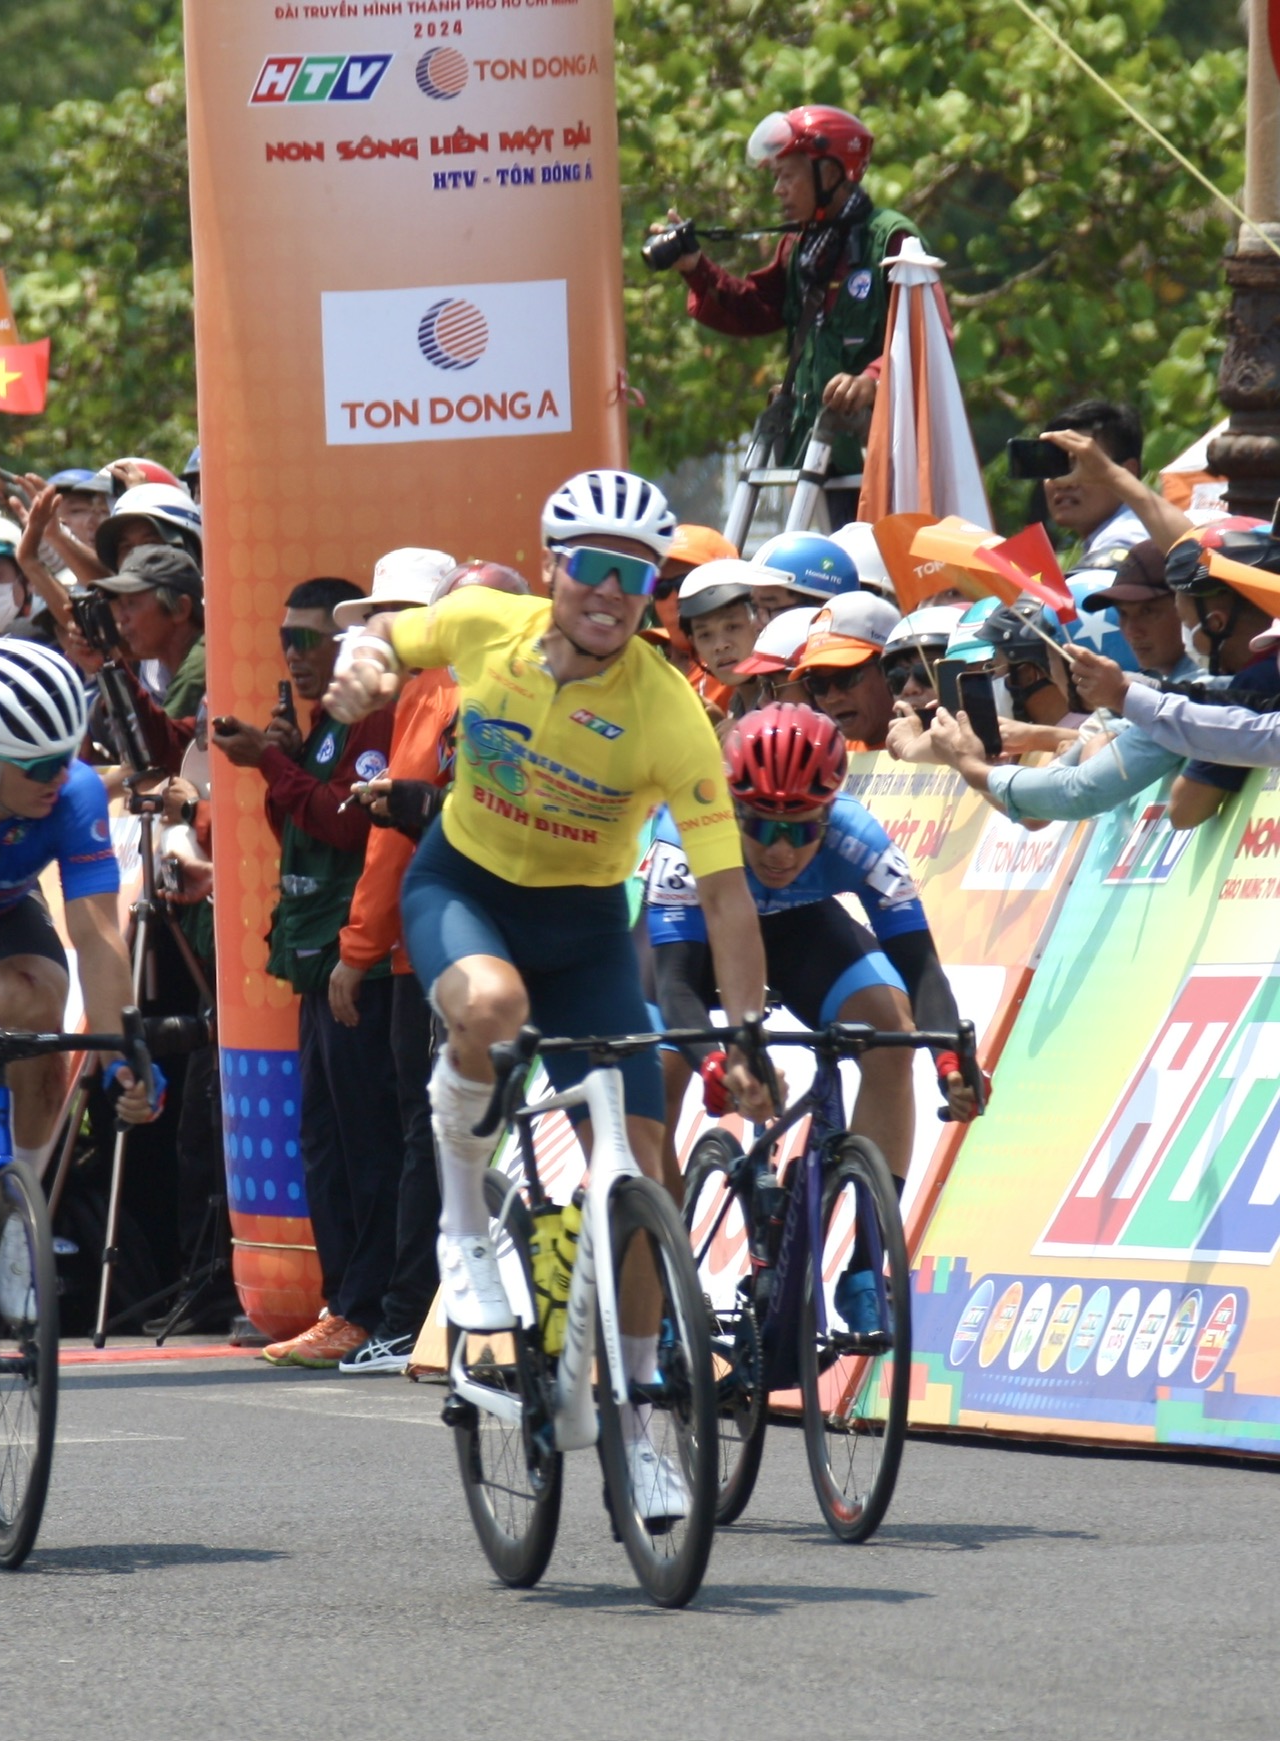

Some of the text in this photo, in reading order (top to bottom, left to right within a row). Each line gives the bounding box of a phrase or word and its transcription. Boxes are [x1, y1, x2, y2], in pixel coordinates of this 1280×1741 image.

[414, 20, 462, 38] 2024
[253, 57, 388, 101] HTV
[473, 59, 526, 81] TON
[266, 141, 324, 162] NON
[336, 135, 419, 162] SÔNG
[430, 125, 489, 156] LIỀN
[499, 125, 554, 155] MỘT
[433, 170, 476, 190] HTV
[496, 163, 535, 186] TÔN
[341, 398, 419, 430] TON
[429, 391, 531, 425] DONG
[805, 569, 843, 585] Honda ITC
[570, 709, 624, 740] HTV
[1234, 817, 1280, 860] NO
